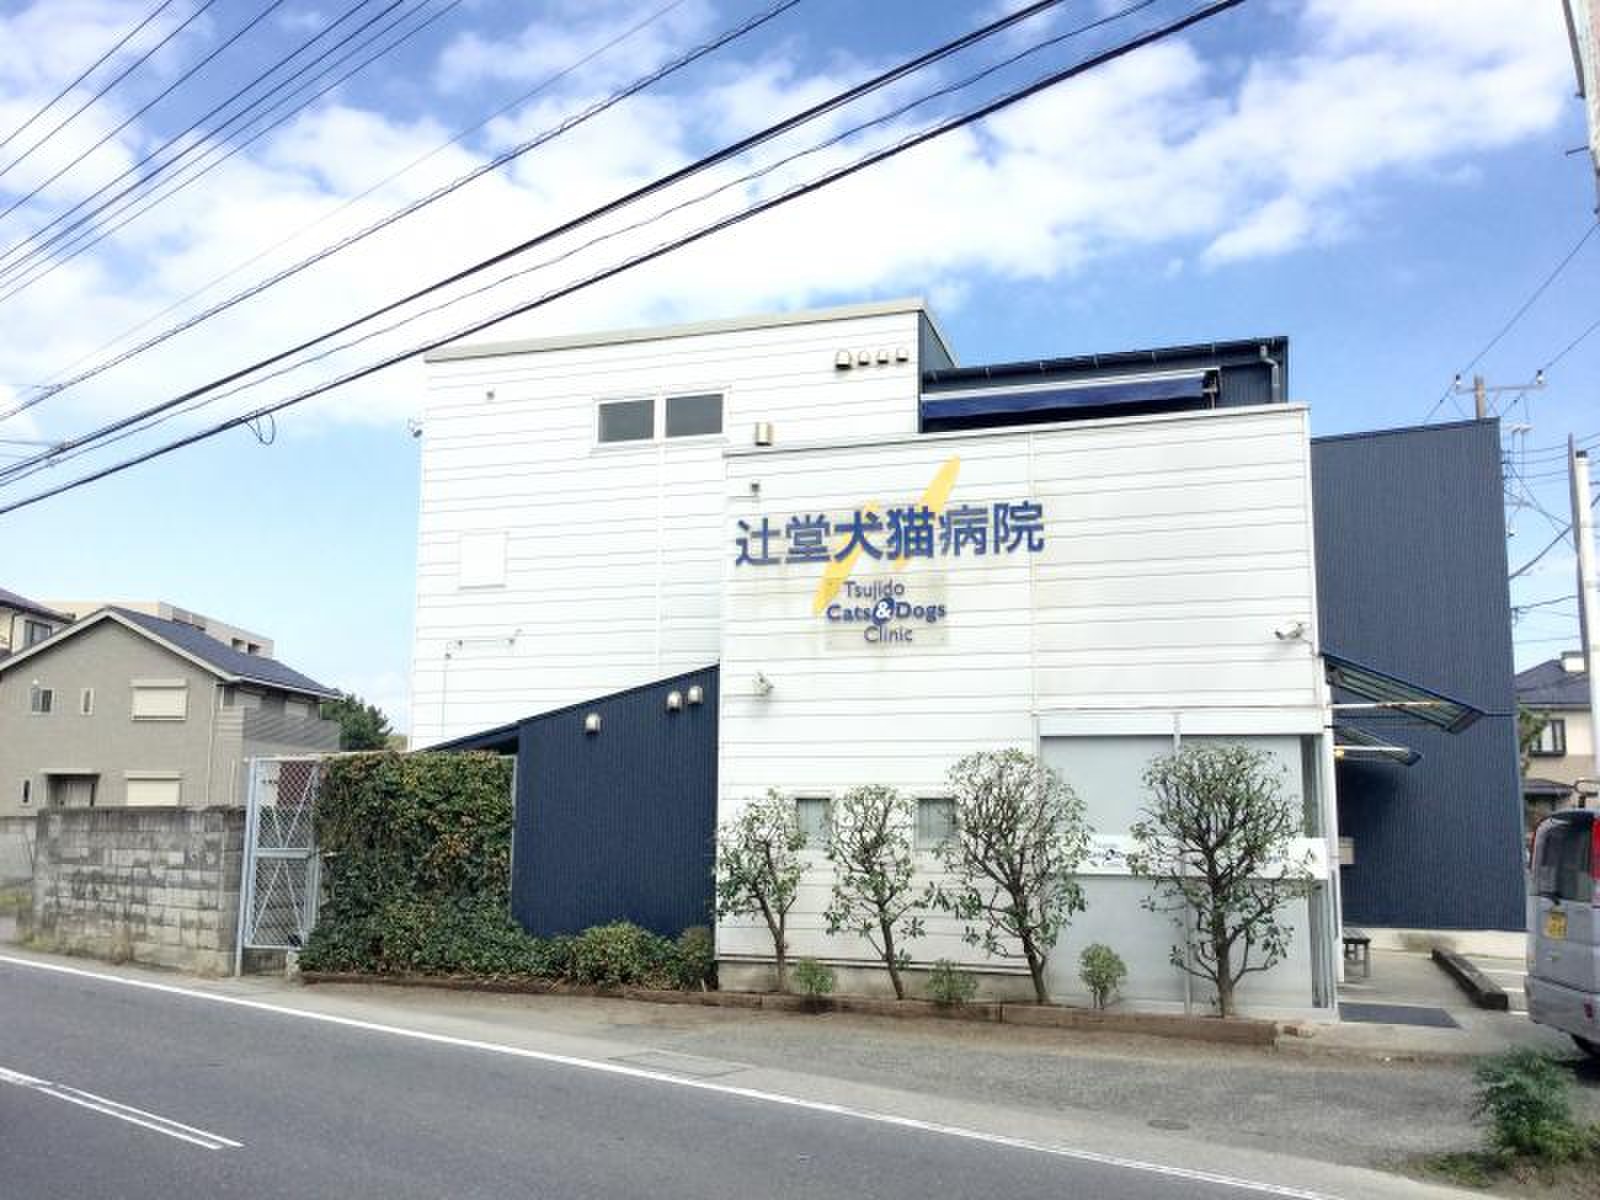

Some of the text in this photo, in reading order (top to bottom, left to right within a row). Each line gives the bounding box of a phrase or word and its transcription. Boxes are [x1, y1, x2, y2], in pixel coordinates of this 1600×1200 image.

[736, 501, 1045, 566] 辻堂犬猫病院
[844, 579, 905, 599] Tsujido
[863, 625, 913, 644] Clinic
